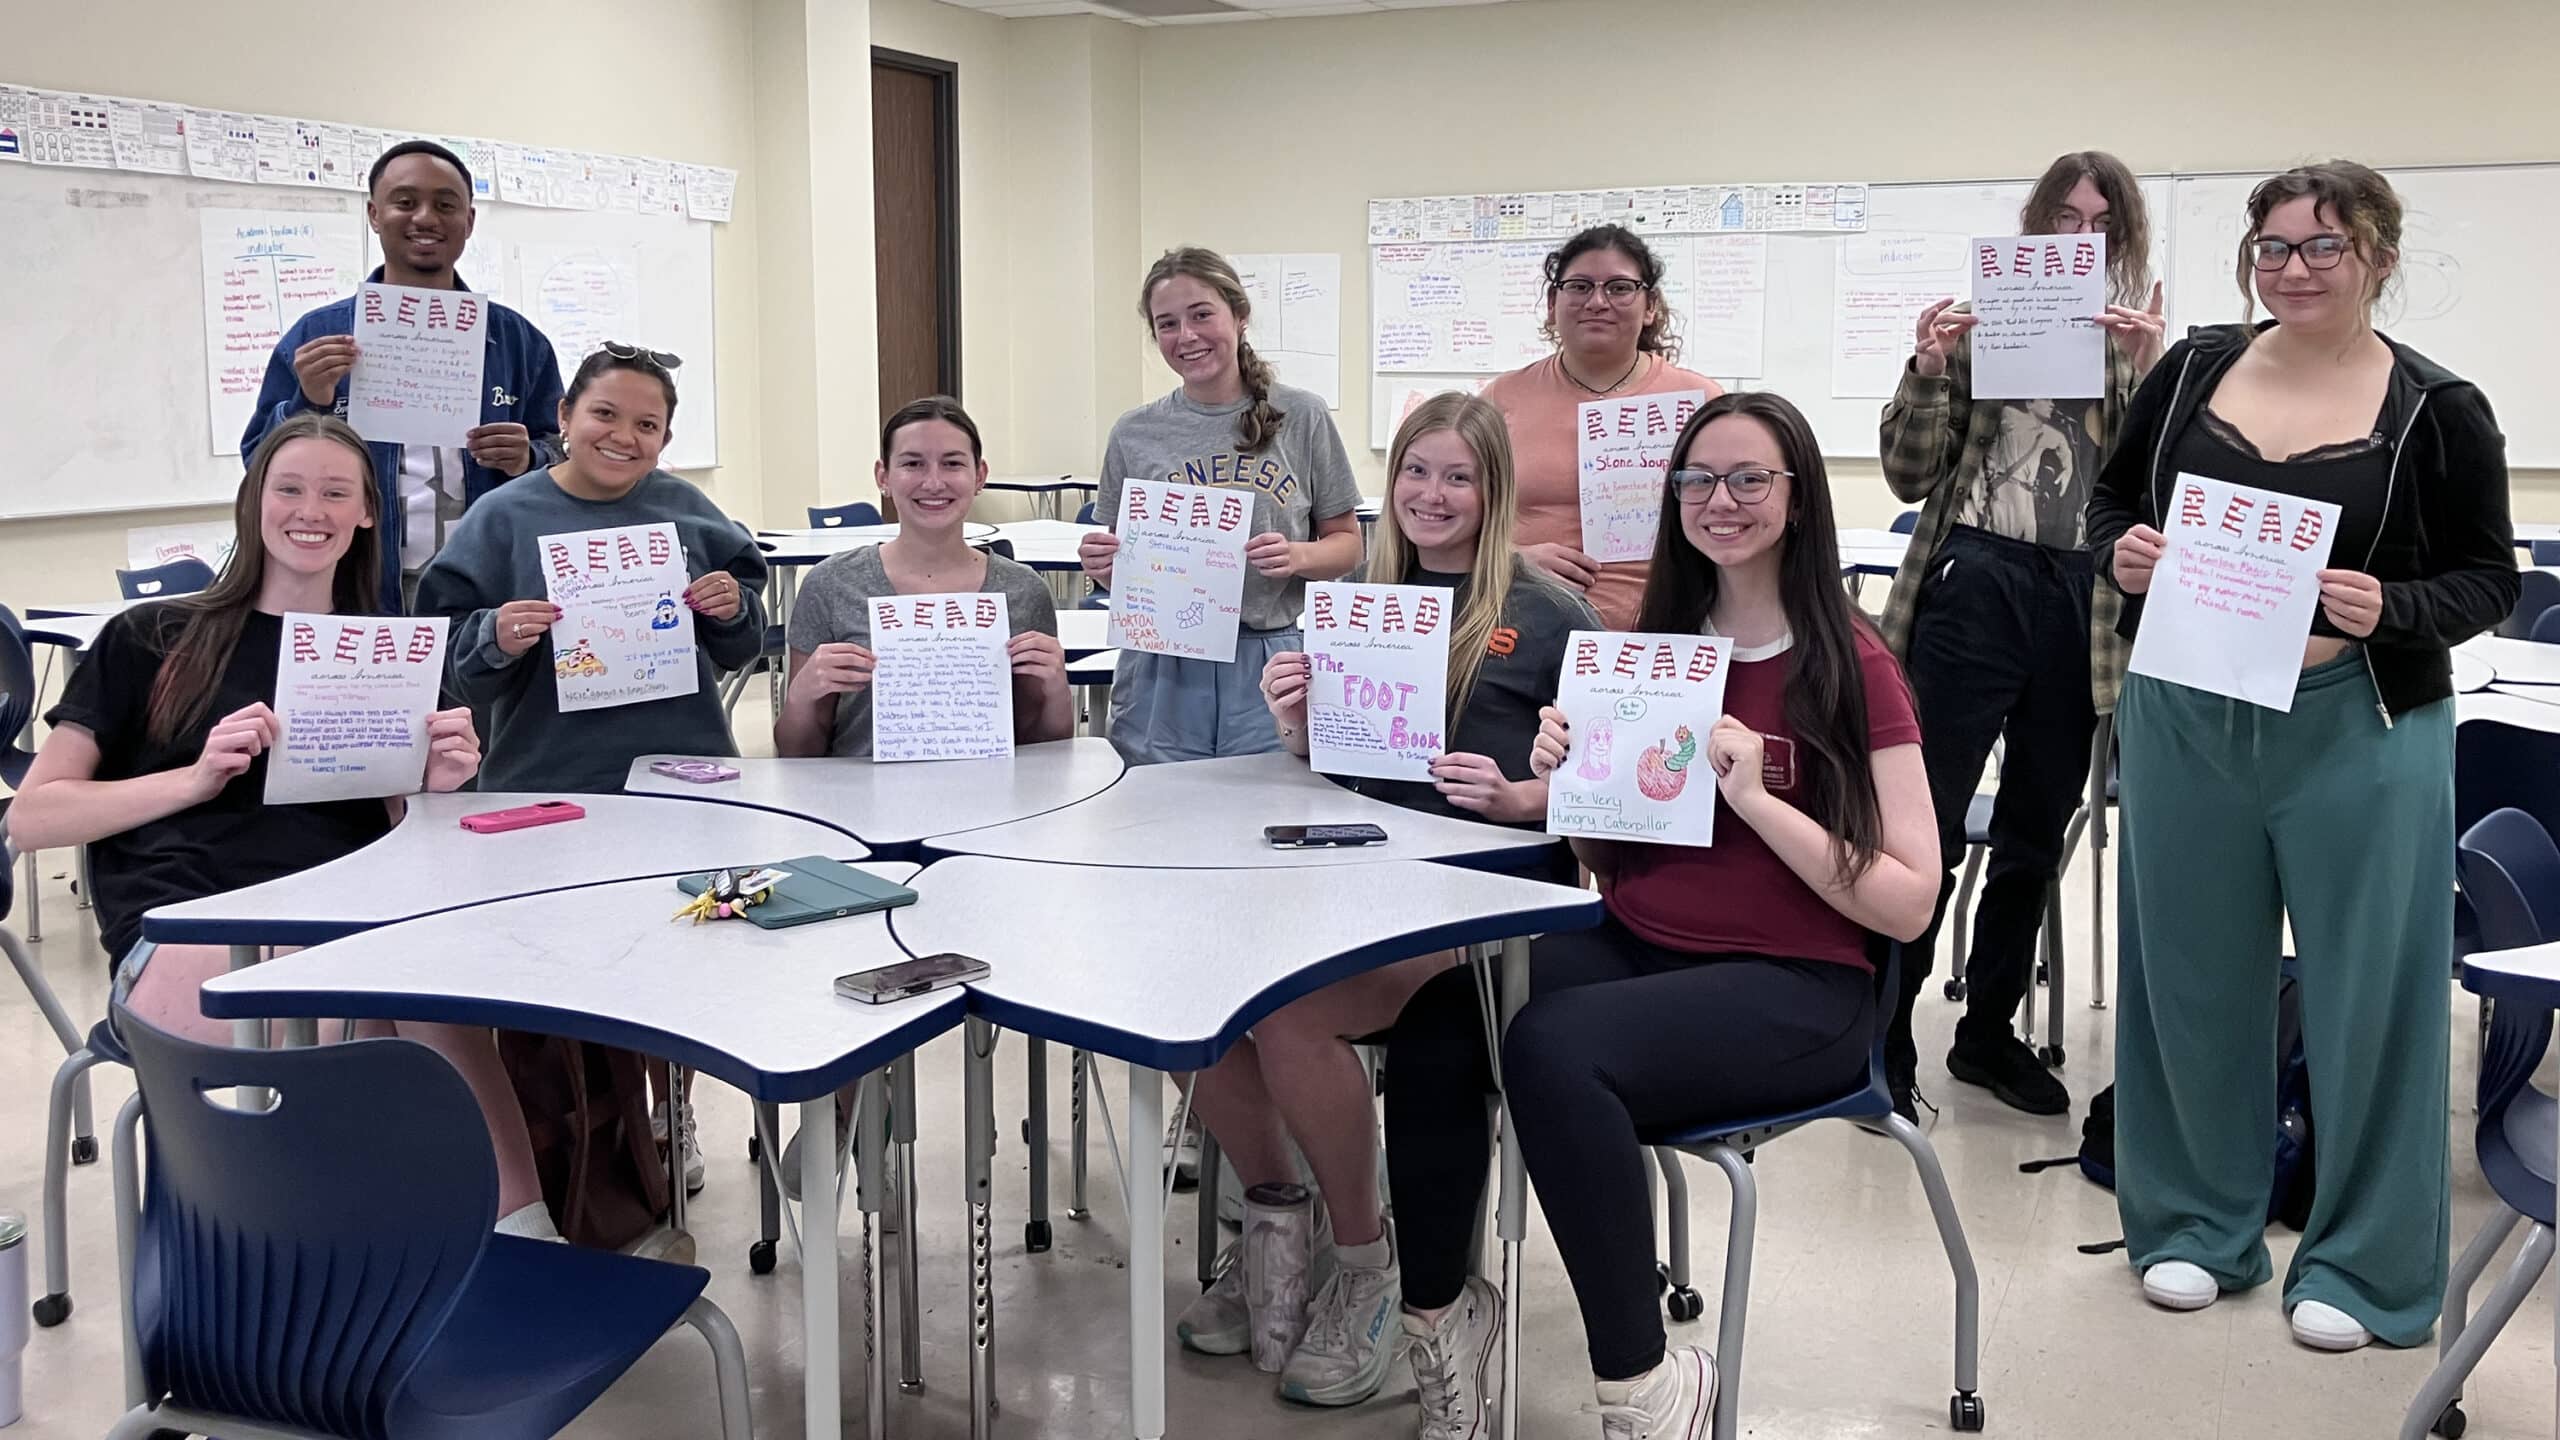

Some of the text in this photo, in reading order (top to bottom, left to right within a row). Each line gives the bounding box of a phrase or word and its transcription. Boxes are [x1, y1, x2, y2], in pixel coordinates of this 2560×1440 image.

[1980, 243, 2095, 278] READ
[2029, 281, 2074, 291] America
[365, 290, 478, 332] READ
[380, 331, 455, 344] across America
[1586, 400, 1696, 440] READ
[1596, 451, 1670, 472] Stone Soup
[1168, 454, 1297, 505] NEESE
[1129, 487, 1242, 531] READ
[2181, 484, 2322, 552] READ
[1141, 530, 1217, 545] across America
[548, 530, 671, 579] READ
[2179, 547, 2193, 559] The
[2194, 539, 2287, 565] across America
[610, 574, 656, 588] America
[877, 598, 997, 630] READ
[1314, 590, 1441, 636] READ
[294, 623, 434, 664] READ
[602, 625, 626, 642] Dog
[931, 631, 978, 642] America
[1125, 629, 1160, 640] HEARS
[1330, 636, 1414, 650] across America
[1313, 653, 1345, 673] The
[1576, 639, 1718, 683] READ
[350, 668, 406, 680] America
[1343, 675, 1418, 711] FOOT
[1590, 684, 1684, 698] across America
[1560, 792, 1622, 814] The Very
[1552, 808, 1672, 832] Hungry Caterpillar
